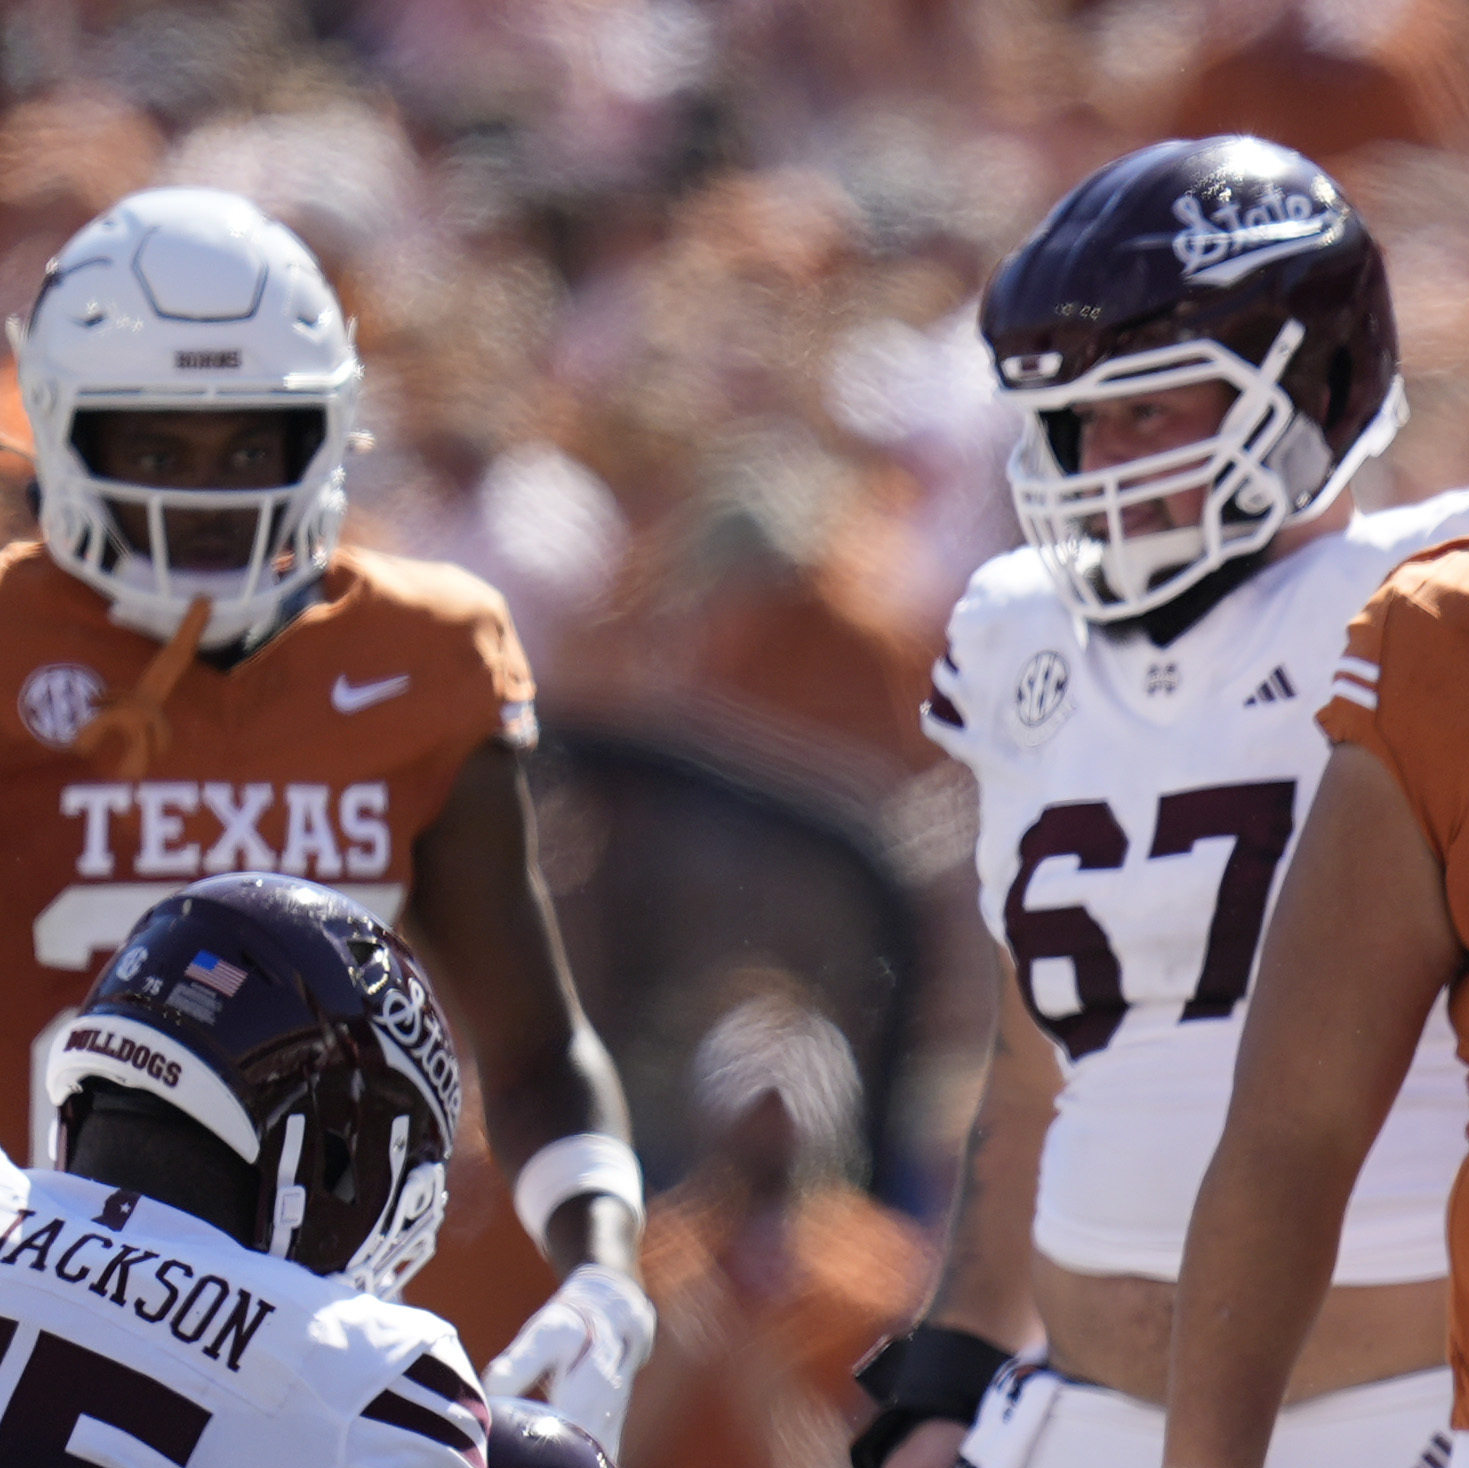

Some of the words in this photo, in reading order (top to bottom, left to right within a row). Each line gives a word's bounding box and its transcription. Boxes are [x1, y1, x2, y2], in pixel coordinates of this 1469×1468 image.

[62, 781, 391, 877] TEXAS
[1003, 779, 1298, 1063] 67
[63, 1030, 183, 1089] BULLDOGS
